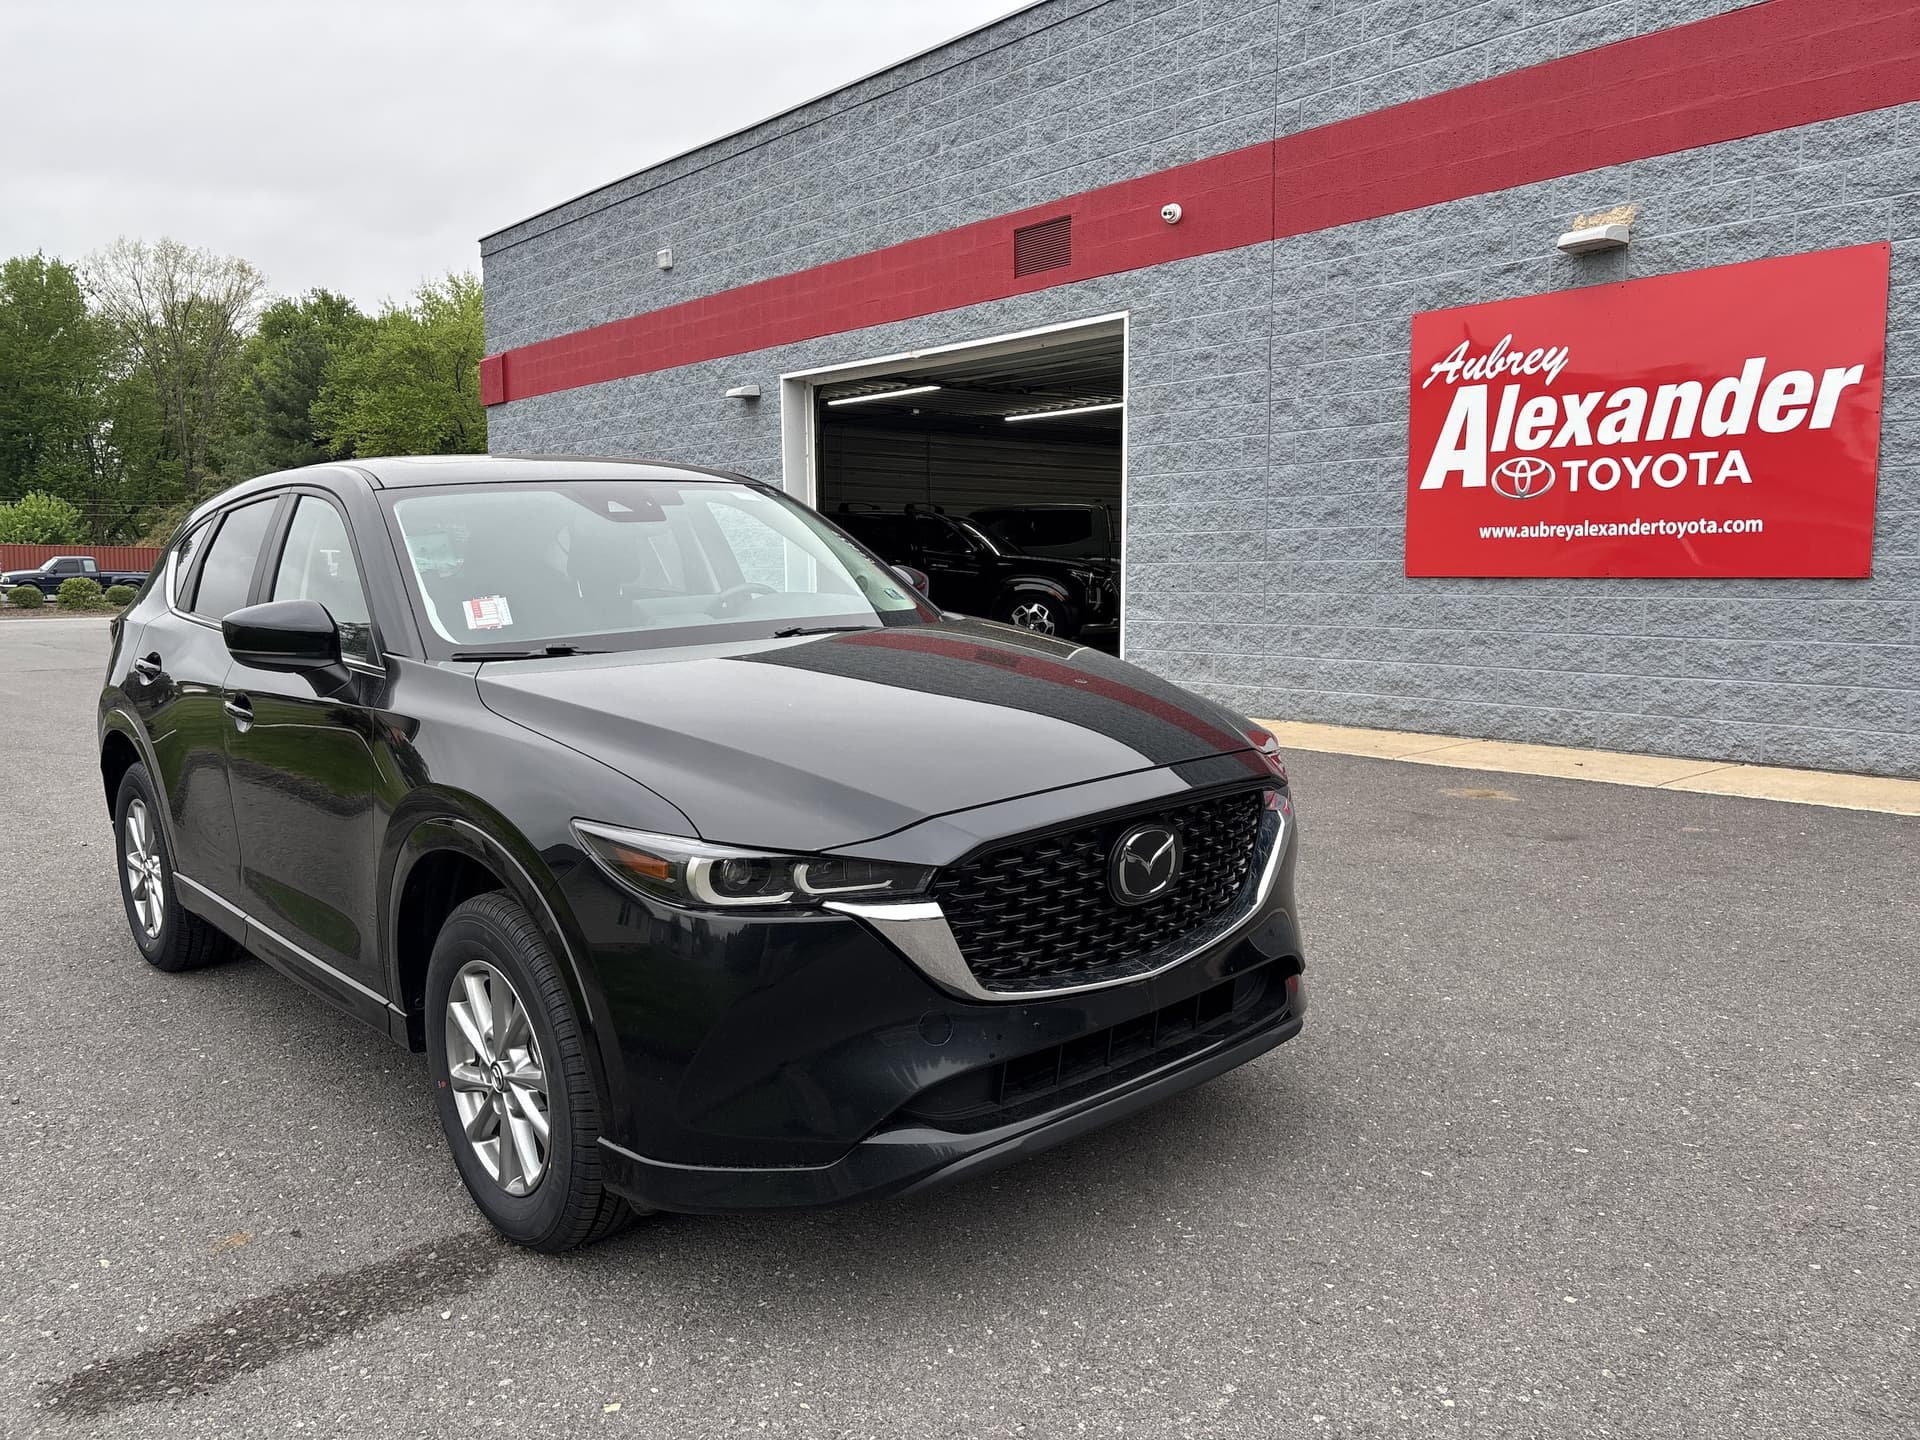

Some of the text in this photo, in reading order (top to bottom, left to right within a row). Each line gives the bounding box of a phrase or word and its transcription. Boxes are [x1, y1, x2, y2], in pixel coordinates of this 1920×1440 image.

[1422, 333, 1569, 389] Aubrey
[1419, 356, 1865, 490] Alexander
[1562, 449, 1753, 493] TOYOTA
[1479, 516, 1764, 541] www.aubreyalexandertoyota.com
